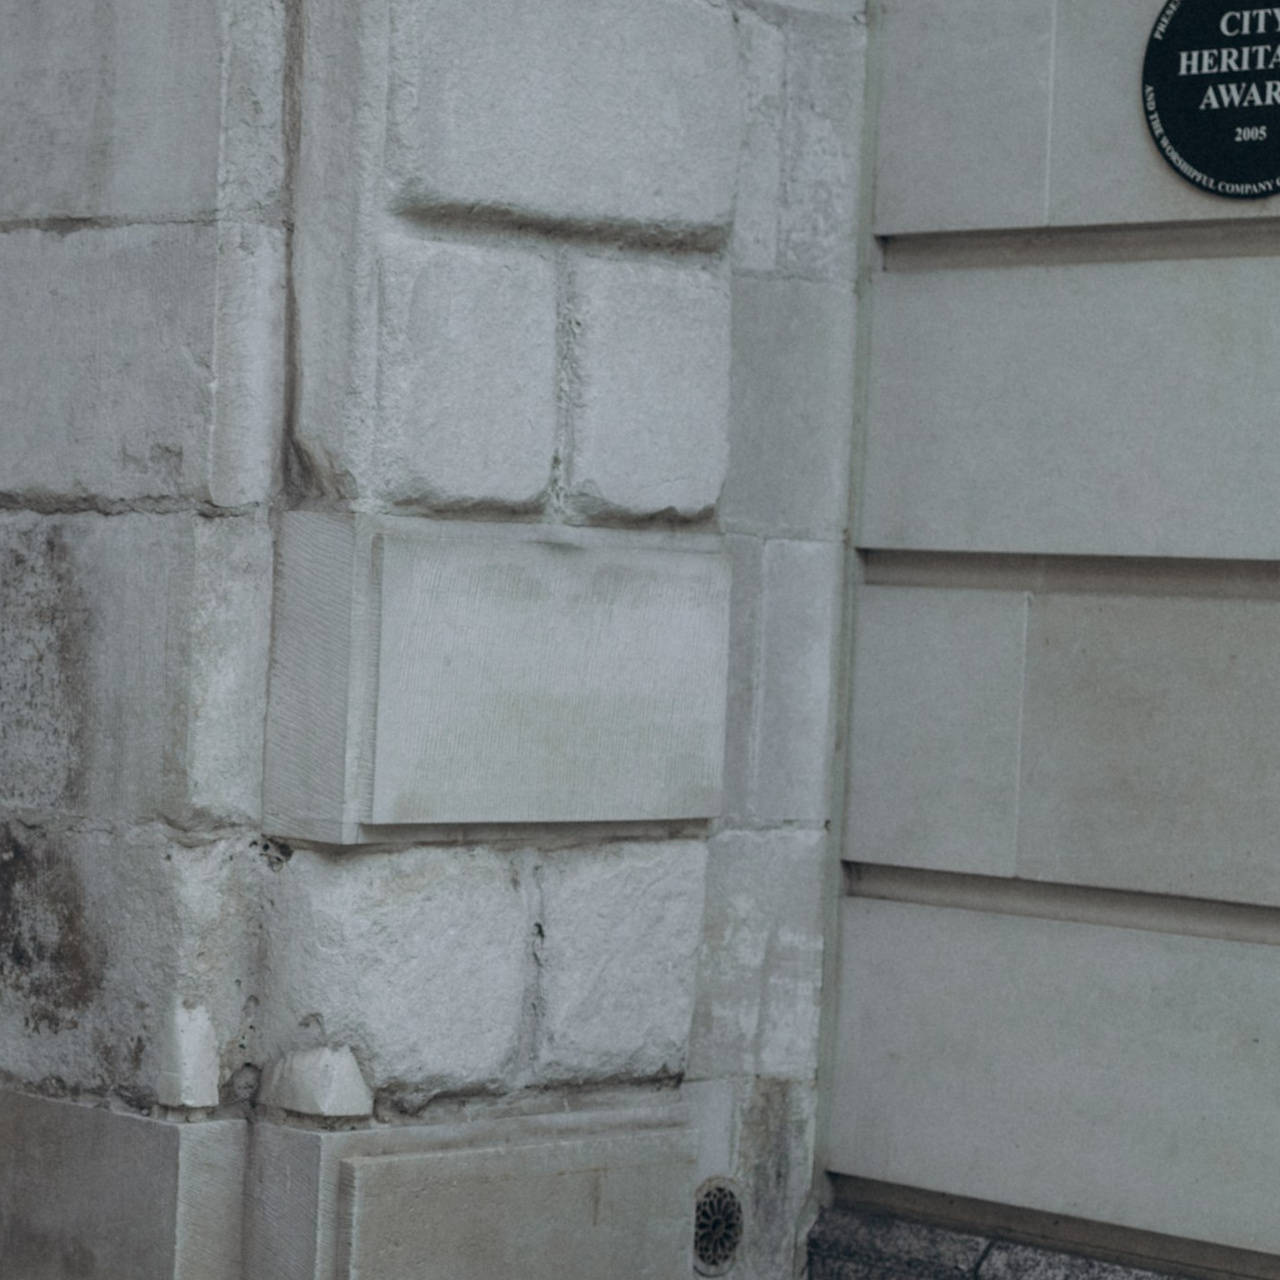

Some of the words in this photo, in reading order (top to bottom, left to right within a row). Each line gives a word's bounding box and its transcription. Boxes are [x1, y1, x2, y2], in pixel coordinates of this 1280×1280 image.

[1145, 84, 1156, 111] AND
[1199, 80, 1280, 110] AWAR
[1149, 111, 1164, 138] THE
[1235, 125, 1267, 142] 2005
[1160, 135, 1216, 190] WORSHIPFUL
[1218, 179, 1274, 195] COMPANY
